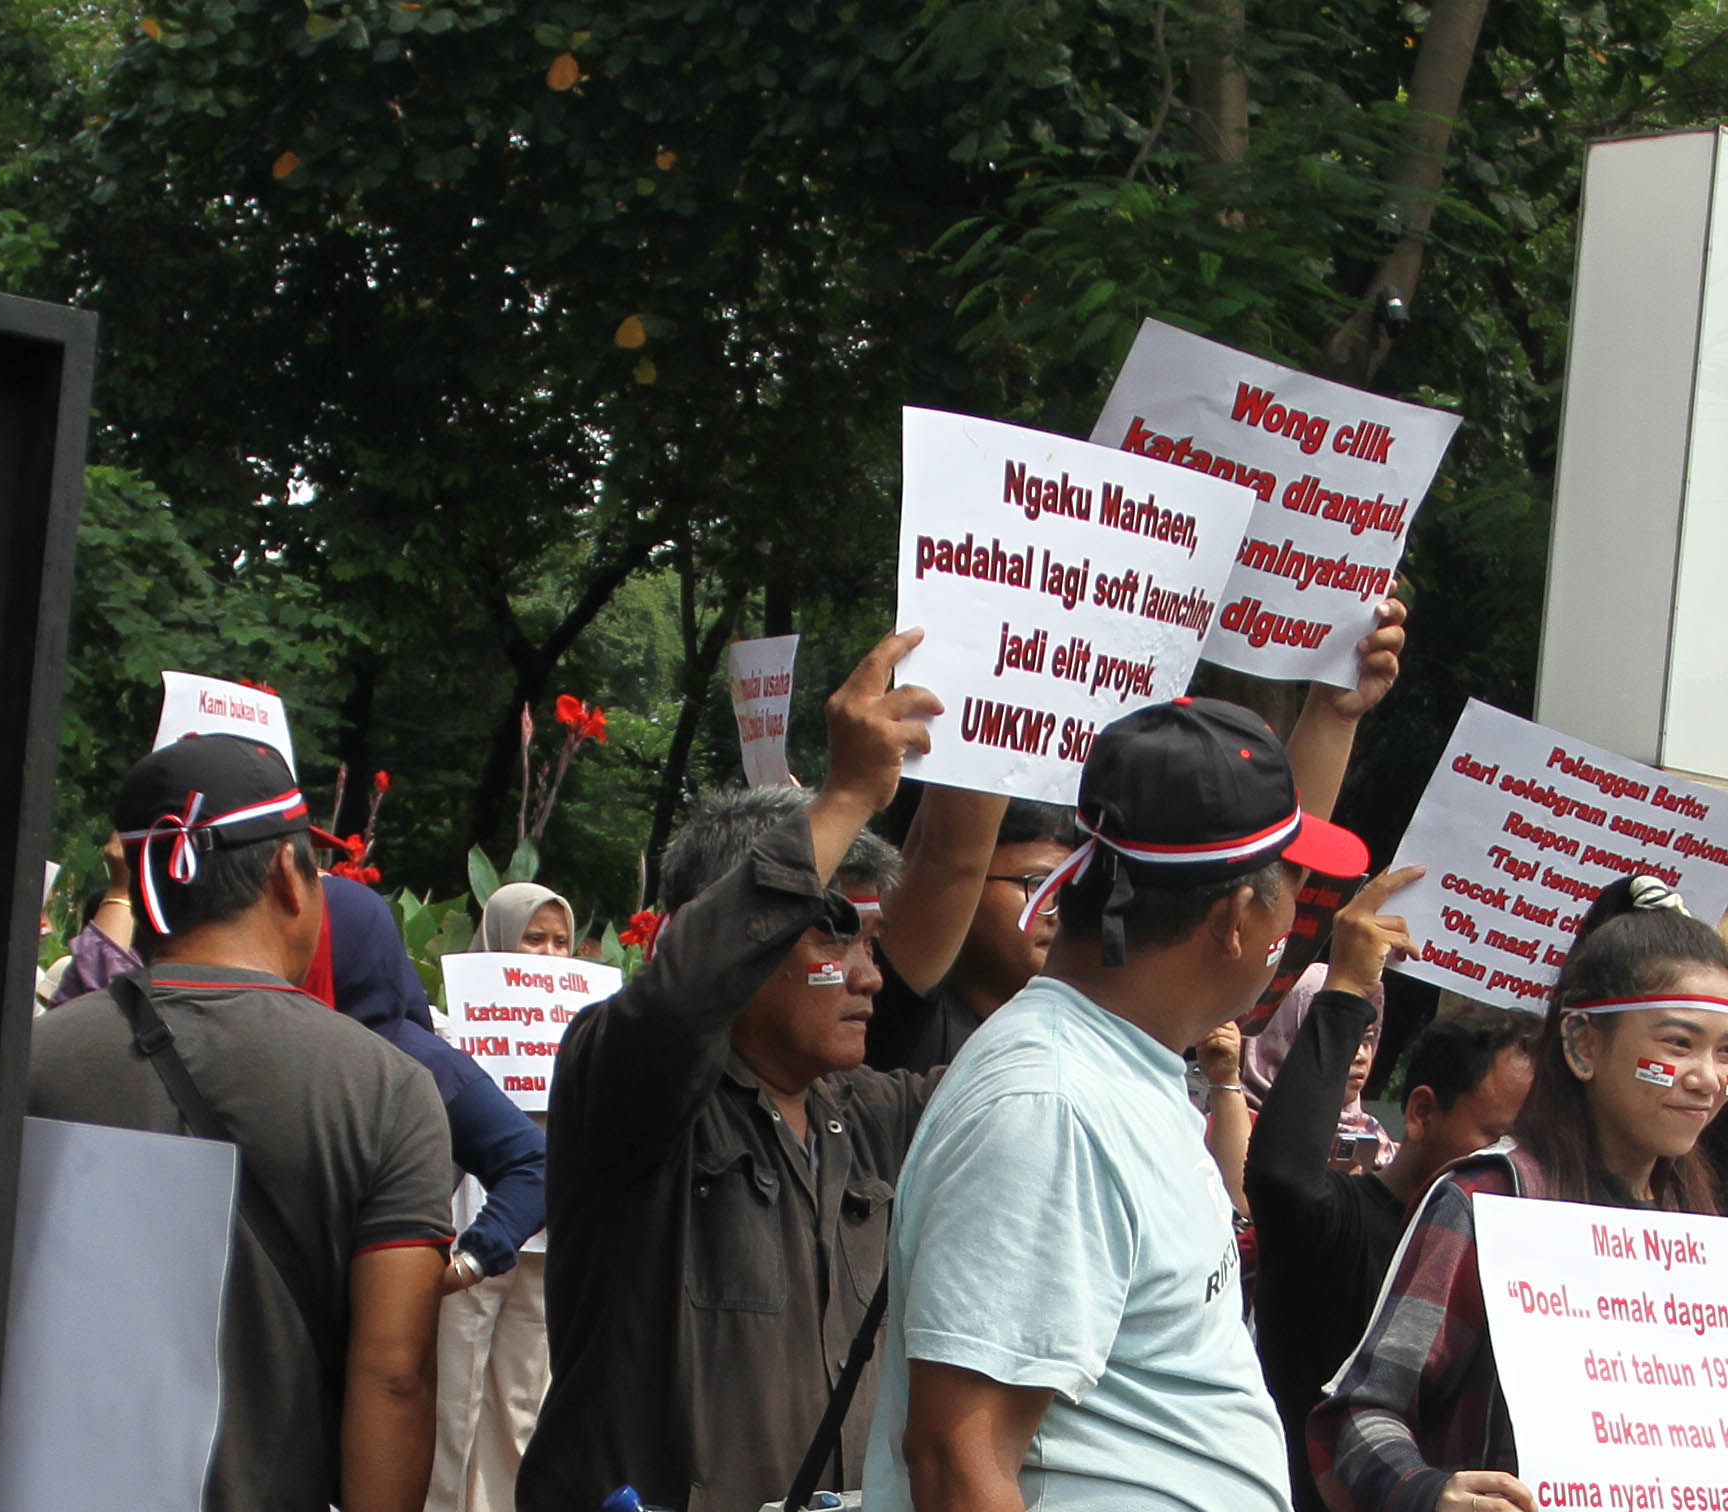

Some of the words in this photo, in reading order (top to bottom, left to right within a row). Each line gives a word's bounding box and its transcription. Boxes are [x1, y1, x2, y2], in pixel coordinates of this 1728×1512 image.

[1231, 382, 1326, 455] Wong
[1333, 419, 1396, 465] cilik
[1003, 460, 1092, 523] Ngaku
[1098, 482, 1198, 558] Marhaen,
[1282, 474, 1409, 541] dirangkul,
[916, 533, 1034, 590] padahal
[1041, 551, 1090, 610] lagi
[1093, 571, 1140, 616] soft
[1139, 575, 1215, 641] launching
[1219, 596, 1332, 650] digusur
[993, 622, 1049, 677] jadi
[1051, 636, 1093, 684] elit
[199, 689, 227, 716] Kami
[960, 696, 1057, 757] UMKM?
[1058, 717, 1101, 763] Ski
[1452, 752, 1498, 785] dari
[1499, 773, 1606, 831] selebgram
[1608, 814, 1676, 851] sampai
[1546, 747, 1648, 802] Pelanggan
[1651, 786, 1710, 822] Barito:
[1502, 812, 1580, 856] Respon
[1441, 873, 1511, 911] cocok
[1510, 895, 1560, 927] buat
[1421, 938, 1487, 981] bukan
[1484, 929, 1541, 965] maaf,
[503, 967, 554, 994] Wong
[559, 973, 590, 995] cilik
[464, 1003, 545, 1026] katanya
[459, 1037, 510, 1057] UKM
[504, 1075, 547, 1092] mau
[1591, 1224, 1638, 1260] Mak
[1643, 1229, 1707, 1271] Nyak:
[1597, 1292, 1658, 1325] emak
[1584, 1349, 1627, 1384] dari
[1632, 1354, 1696, 1388] tahun
[1591, 1410, 1663, 1447] Bukan
[1670, 1421, 1715, 1450] mau
[1538, 1480, 1603, 1508] cuma
